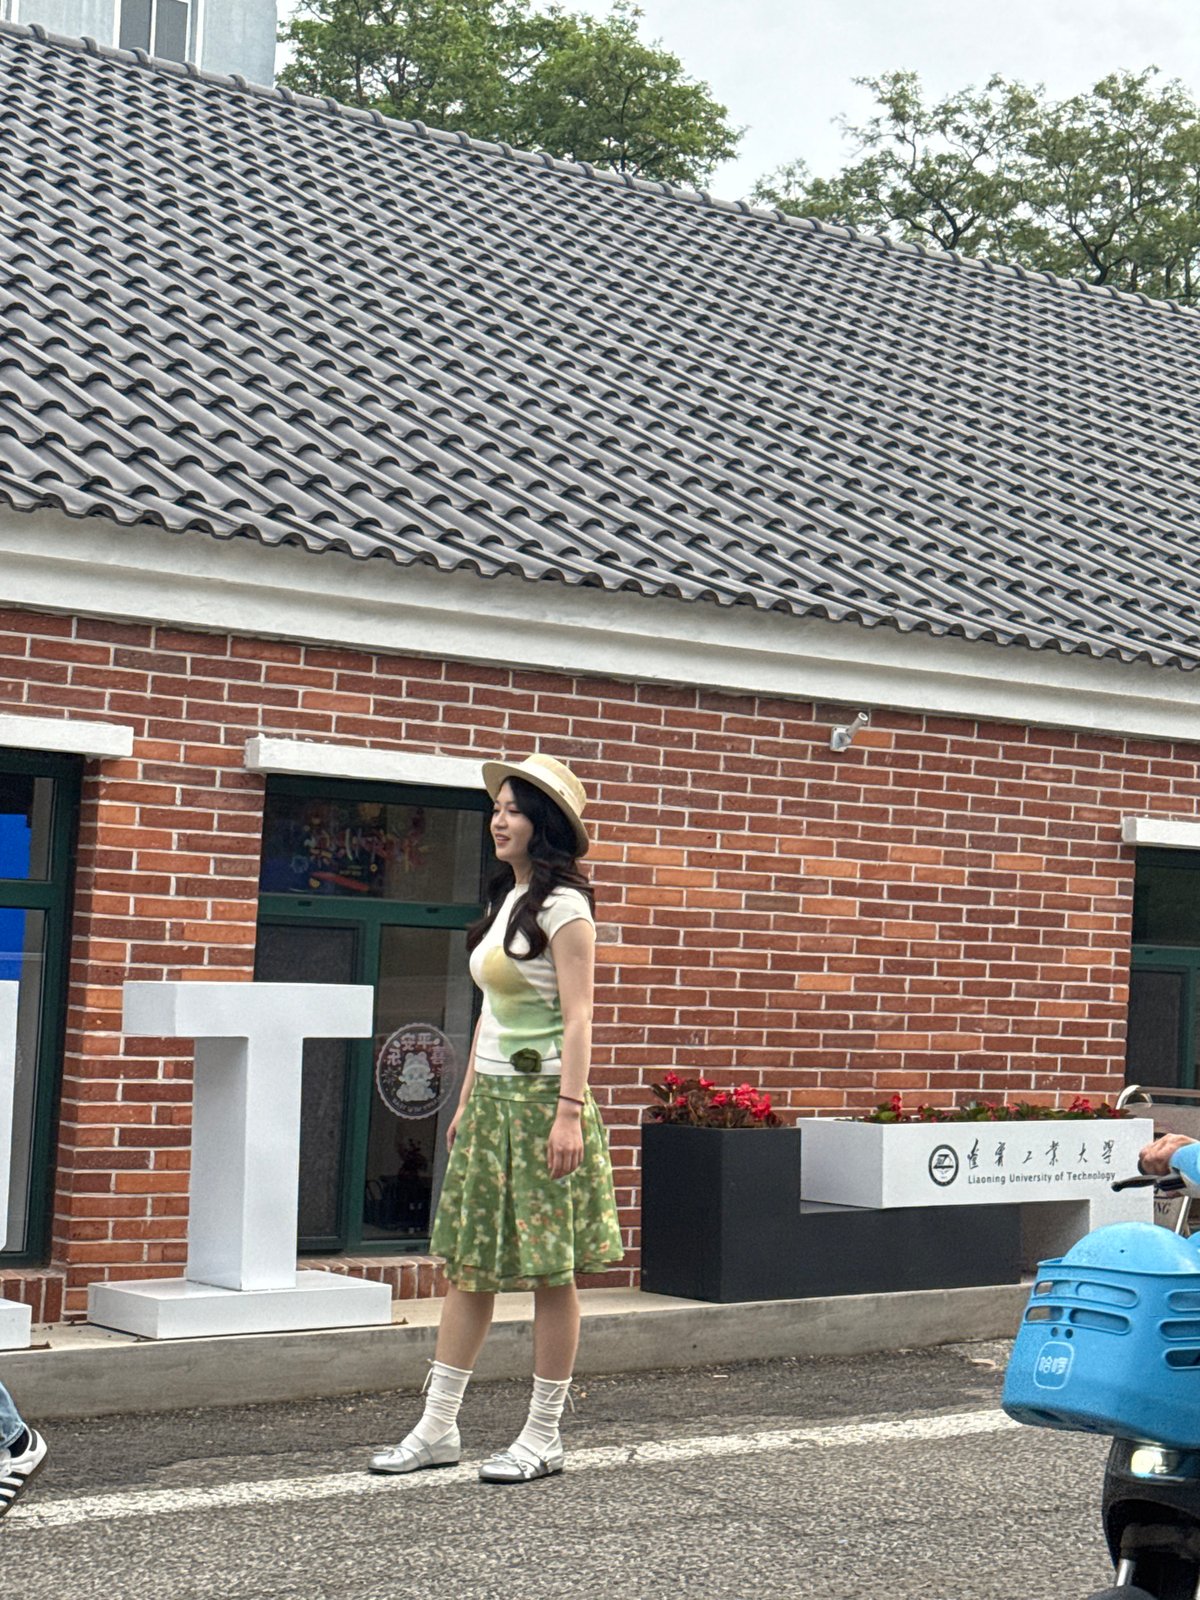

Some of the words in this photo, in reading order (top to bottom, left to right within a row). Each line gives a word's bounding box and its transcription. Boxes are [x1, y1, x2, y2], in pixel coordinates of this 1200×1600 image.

[122, 981, 374, 1290] T
[968, 1174, 1006, 1185] Liaoning
[1009, 1172, 1052, 1183] University
[1055, 1171, 1064, 1181] of
[1066, 1170, 1116, 1182] Technology
